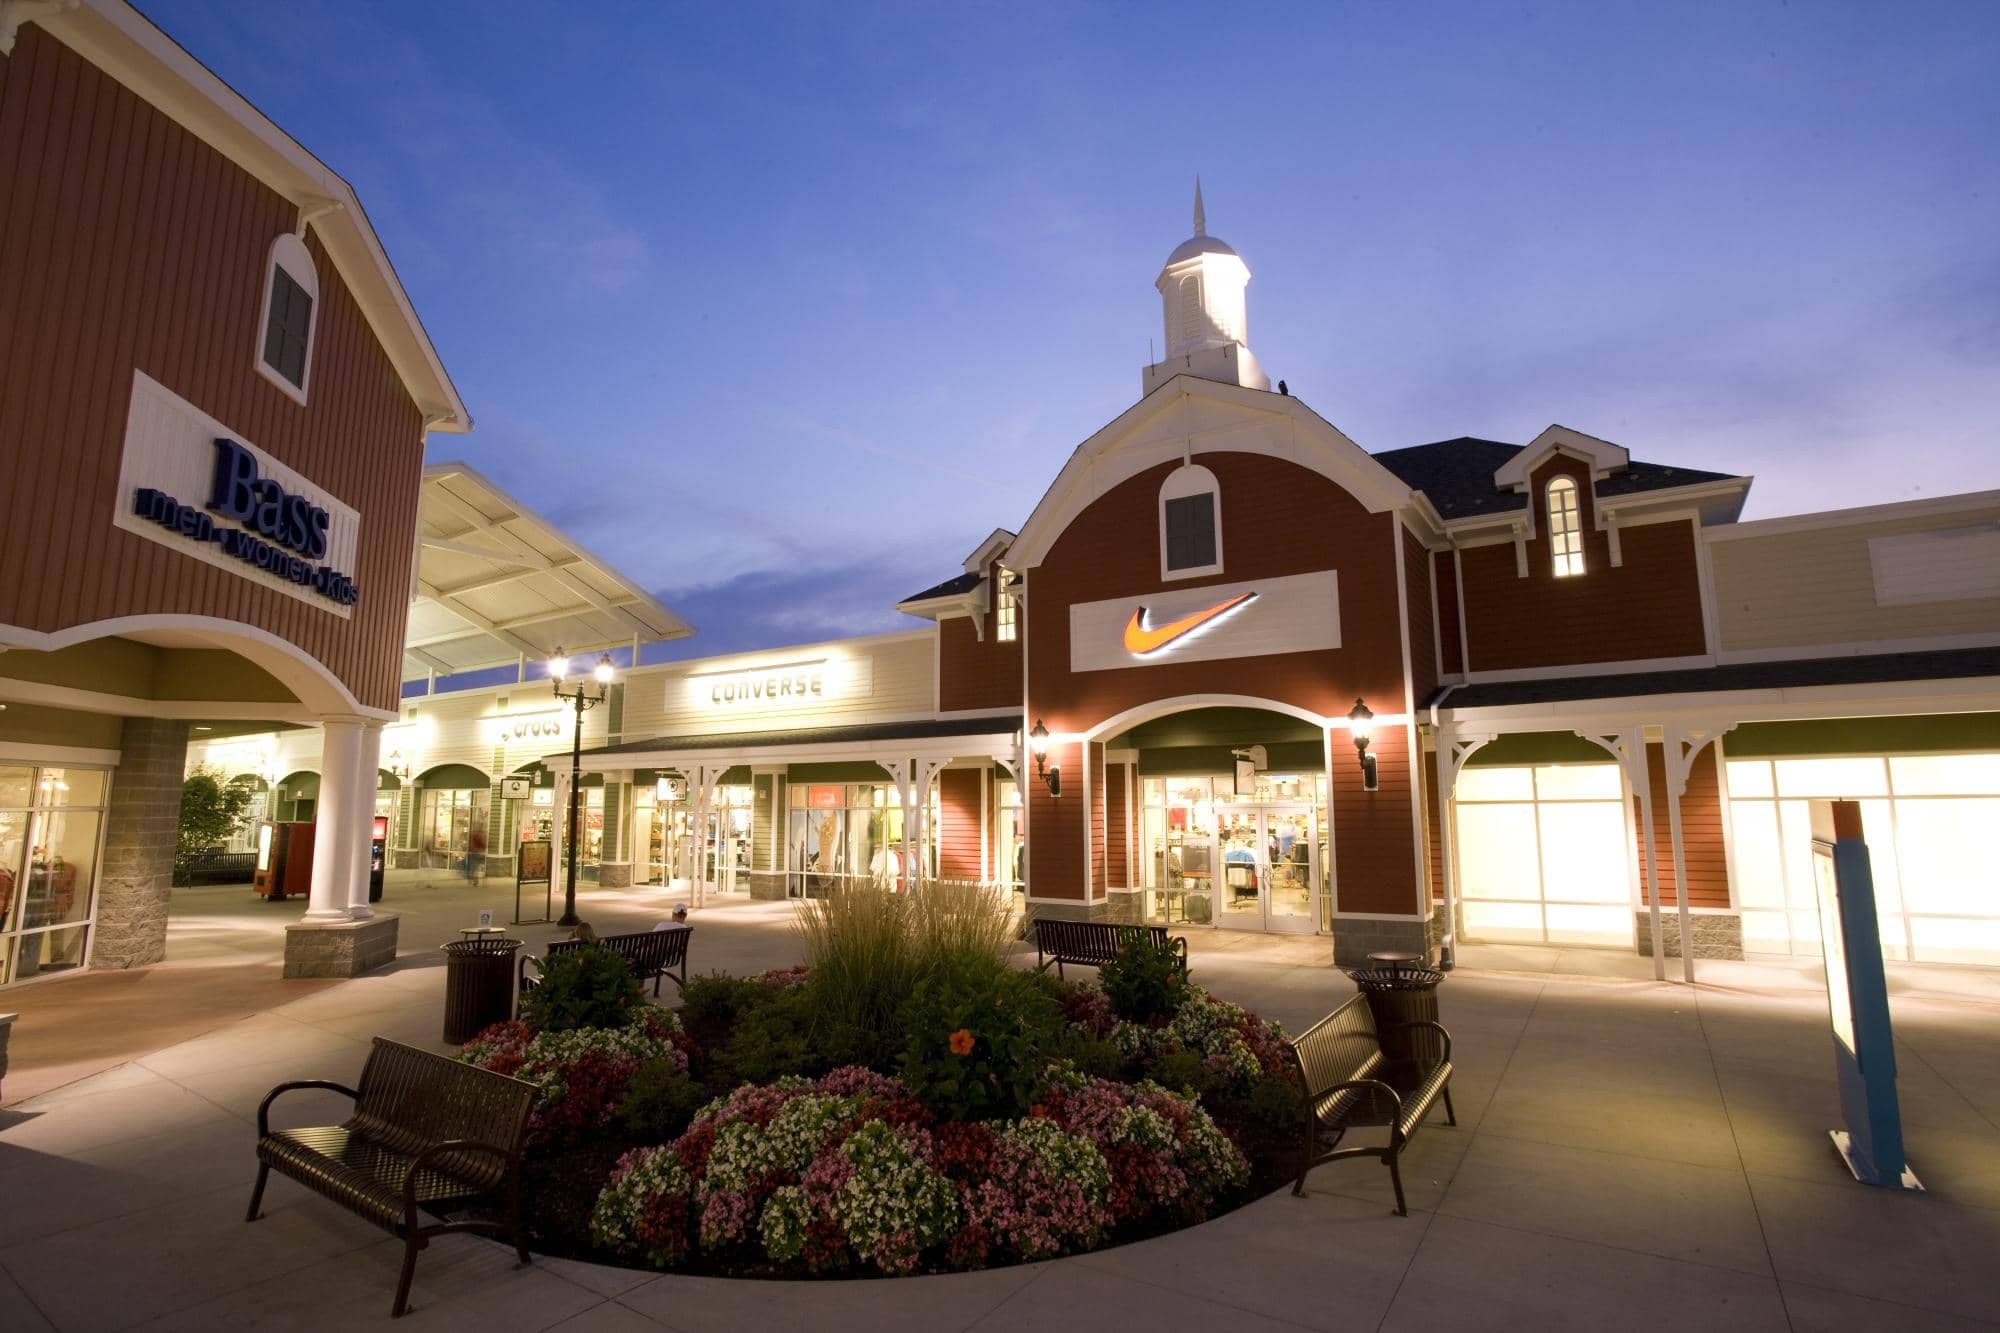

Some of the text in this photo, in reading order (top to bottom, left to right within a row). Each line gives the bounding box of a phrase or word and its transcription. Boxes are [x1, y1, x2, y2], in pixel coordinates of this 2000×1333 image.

[205, 438, 330, 560] Bass
[134, 487, 359, 606] men women kids
[711, 673, 822, 704] CONVERSE
[513, 718, 561, 738] crocs
